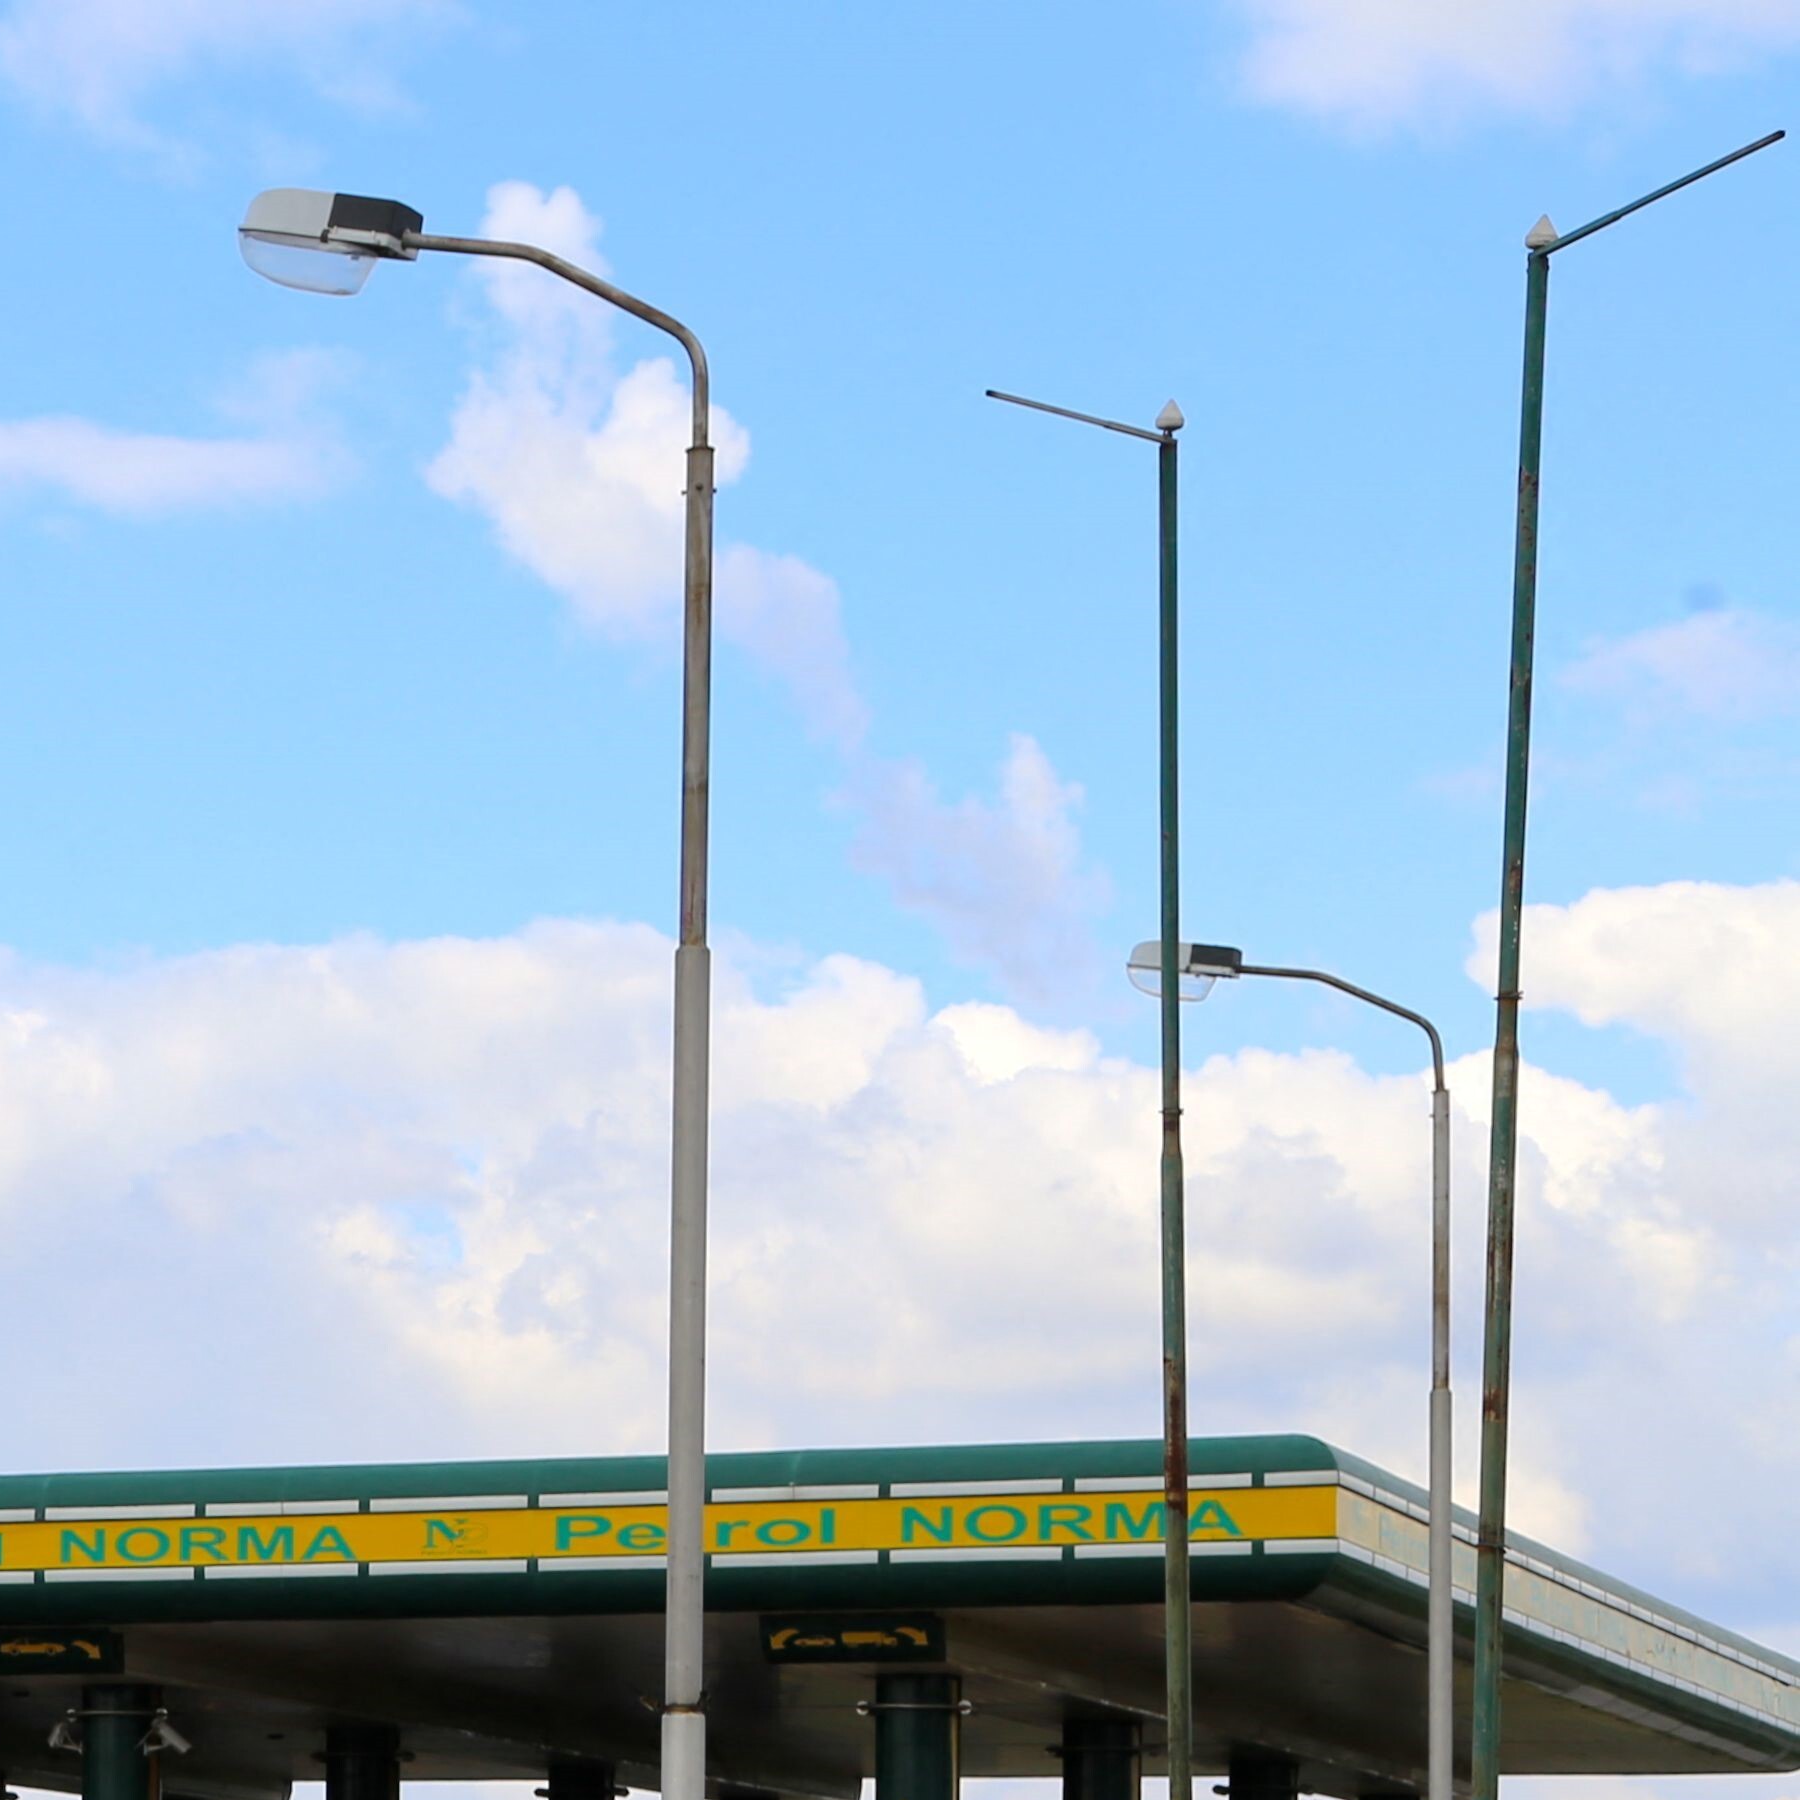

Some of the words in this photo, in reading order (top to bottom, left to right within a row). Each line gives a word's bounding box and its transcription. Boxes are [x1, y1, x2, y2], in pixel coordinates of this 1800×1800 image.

[59, 1526, 357, 1563] NORMA
[554, 1508, 837, 1551] Perol
[900, 1499, 1244, 1543] NORMA
